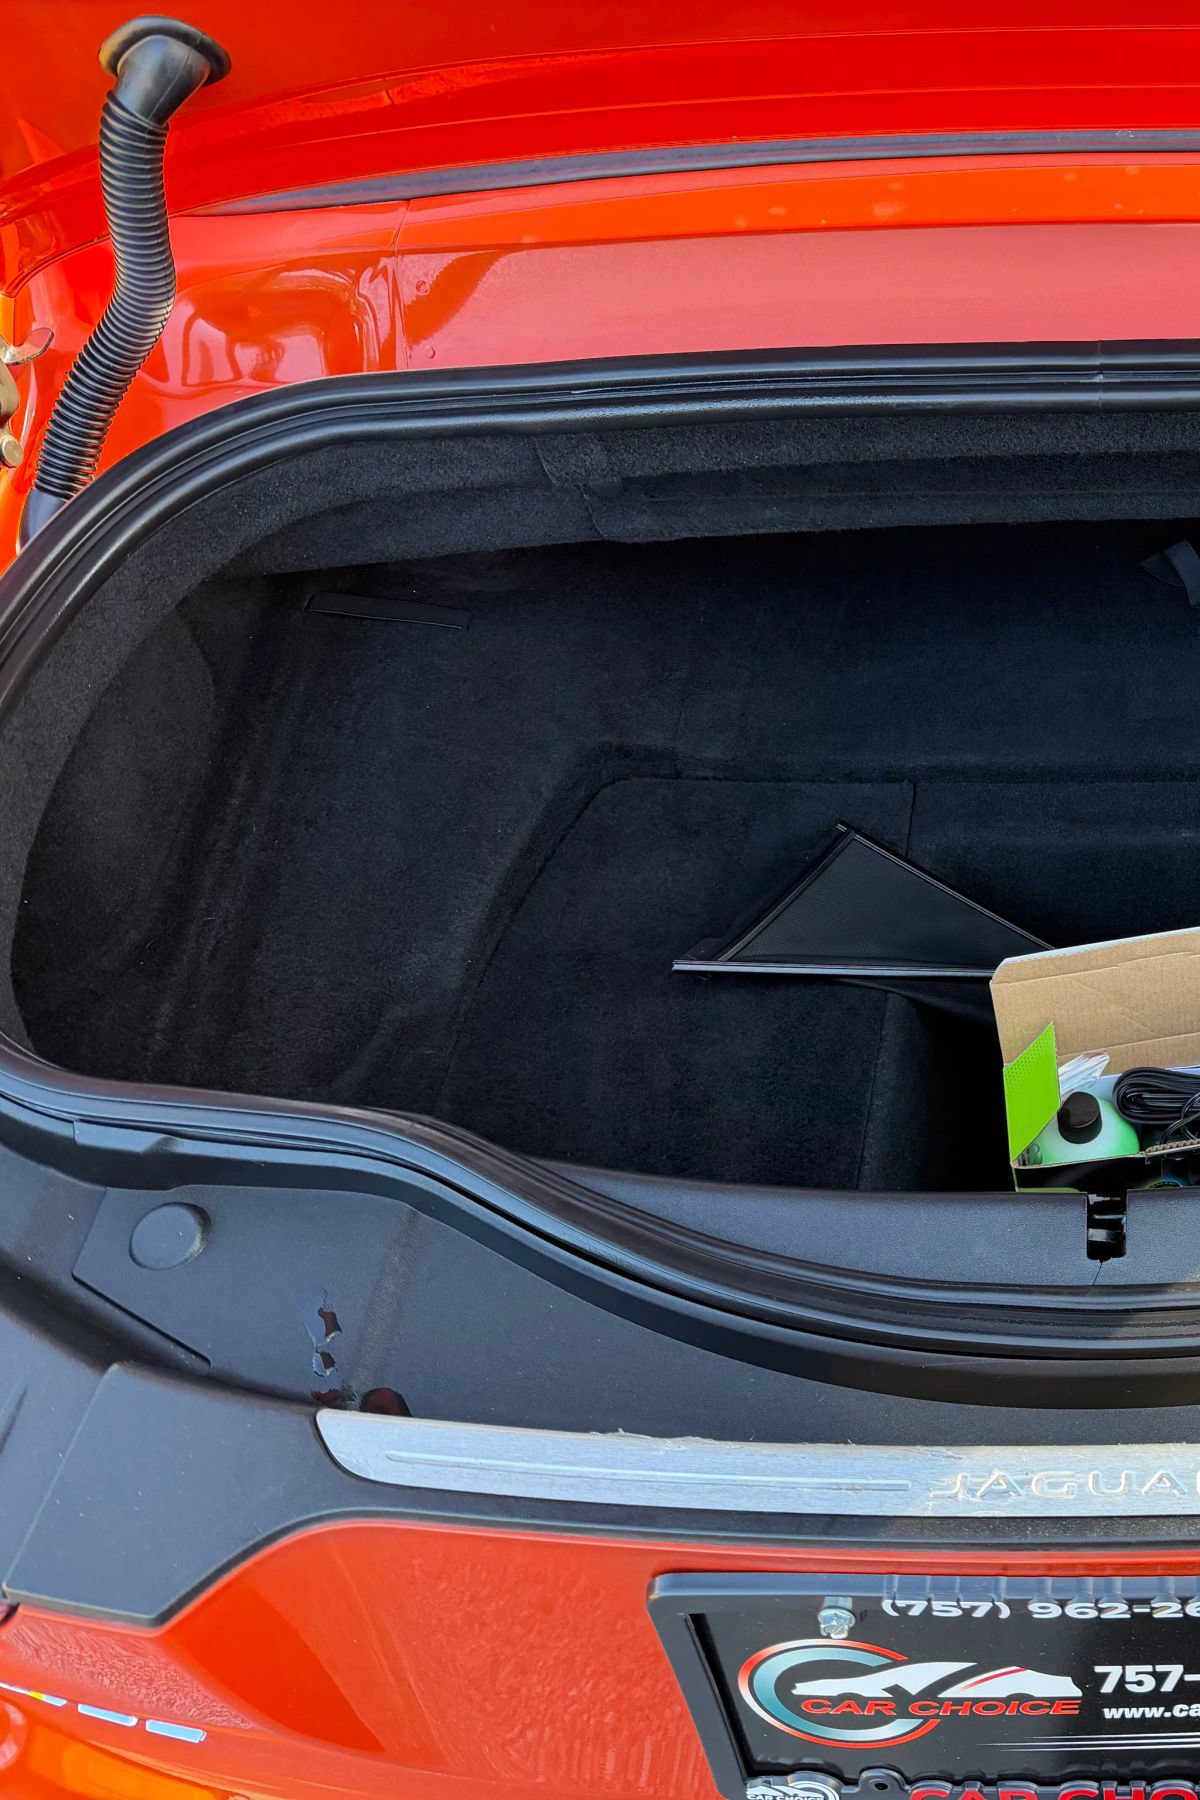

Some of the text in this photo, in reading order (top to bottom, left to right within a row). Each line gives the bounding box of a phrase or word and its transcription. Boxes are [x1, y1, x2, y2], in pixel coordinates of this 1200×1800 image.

[881, 1599, 1011, 1619] (757)
[801, 1698, 1082, 1716] CAR CHOICE
